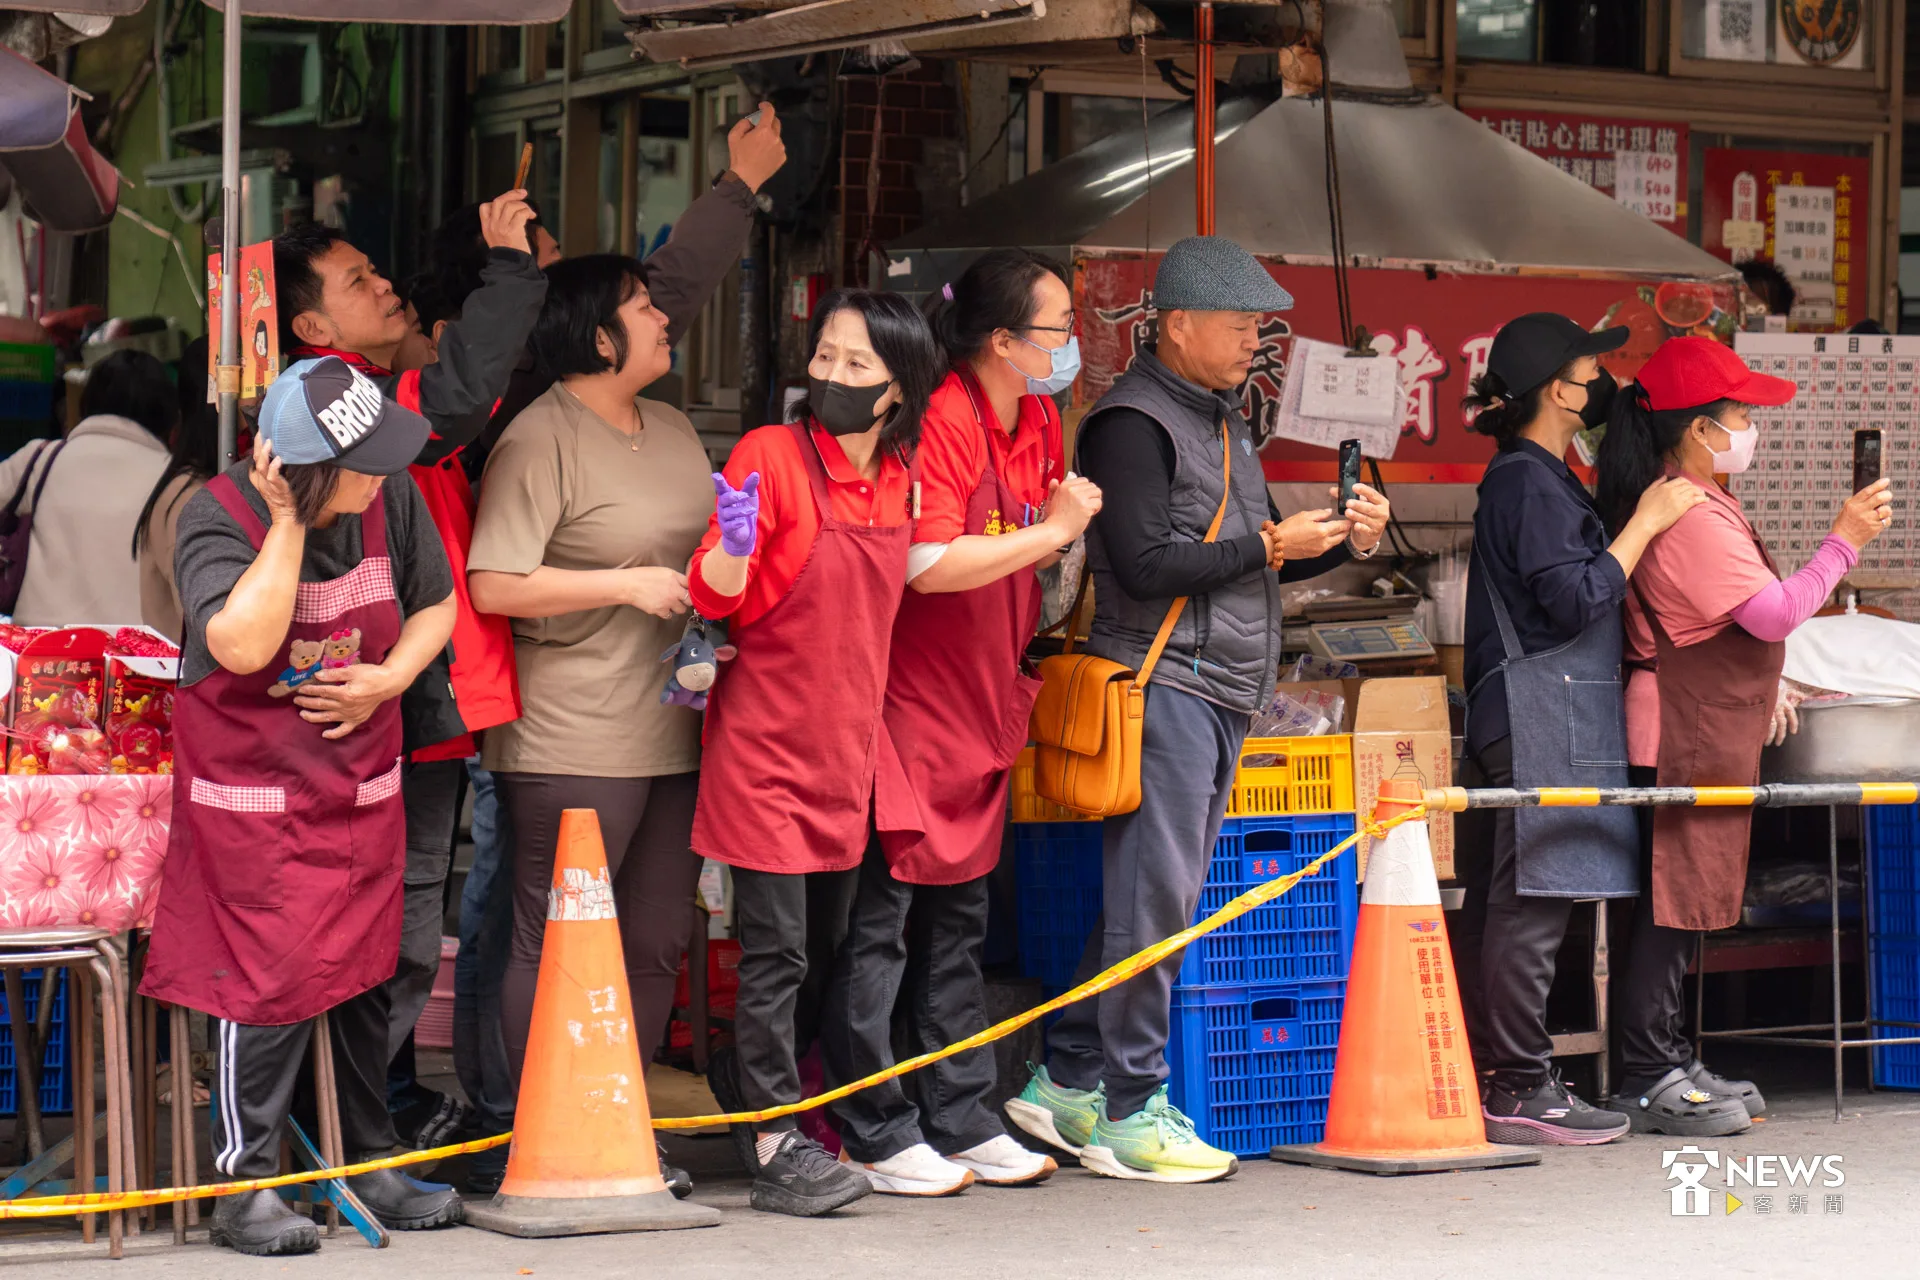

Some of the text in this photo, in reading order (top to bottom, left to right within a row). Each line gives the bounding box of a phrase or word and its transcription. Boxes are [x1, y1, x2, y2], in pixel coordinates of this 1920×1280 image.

[1814, 337, 1893, 353] 價目表
[1750, 361, 1761, 371] 270
[1774, 361, 1784, 371] 540
[1798, 361, 1808, 371] 810
[1820, 361, 1835, 371] 1080
[1820, 380, 1834, 390] 1097
[1871, 380, 1886, 390] 1637
[1896, 380, 1911, 390] 1907
[1796, 400, 1806, 410] 844
[1819, 400, 1834, 410] 1114
[1845, 400, 1860, 410] 1384
[1870, 400, 1885, 410] 1654
[1896, 400, 1910, 410] 1924
[1771, 420, 1782, 430] 591
[1818, 420, 1833, 430] 1131
[1844, 420, 1859, 430] 1401
[1895, 420, 1909, 430] 1941
[1817, 440, 1832, 450] 1148
[1894, 440, 1908, 450] 1958
[1769, 460, 1780, 470] 624
[1793, 460, 1803, 470] 894
[1816, 460, 1831, 470] 1164
[1893, 460, 1908, 470] 1974
[1744, 480, 1755, 490] 371
[1768, 480, 1779, 490] 641
[1792, 480, 1802, 490] 911
[1815, 480, 1830, 490] 1181
[1892, 480, 1907, 490] 1991
[1792, 500, 1802, 510] 928
[1814, 500, 1829, 510] 1198
[1766, 520, 1777, 529] 675
[1791, 520, 1801, 529] 945
[1813, 520, 1828, 529] 1215
[1890, 520, 1905, 529] 2025
[1790, 540, 1800, 549] 962
[1889, 540, 1904, 549] 2042
[1863, 559, 1878, 569] 1789
[1888, 559, 1903, 569] 2059
[1252, 858, 1280, 876] 萬泰
[1262, 1026, 1290, 1044] 萬泰
